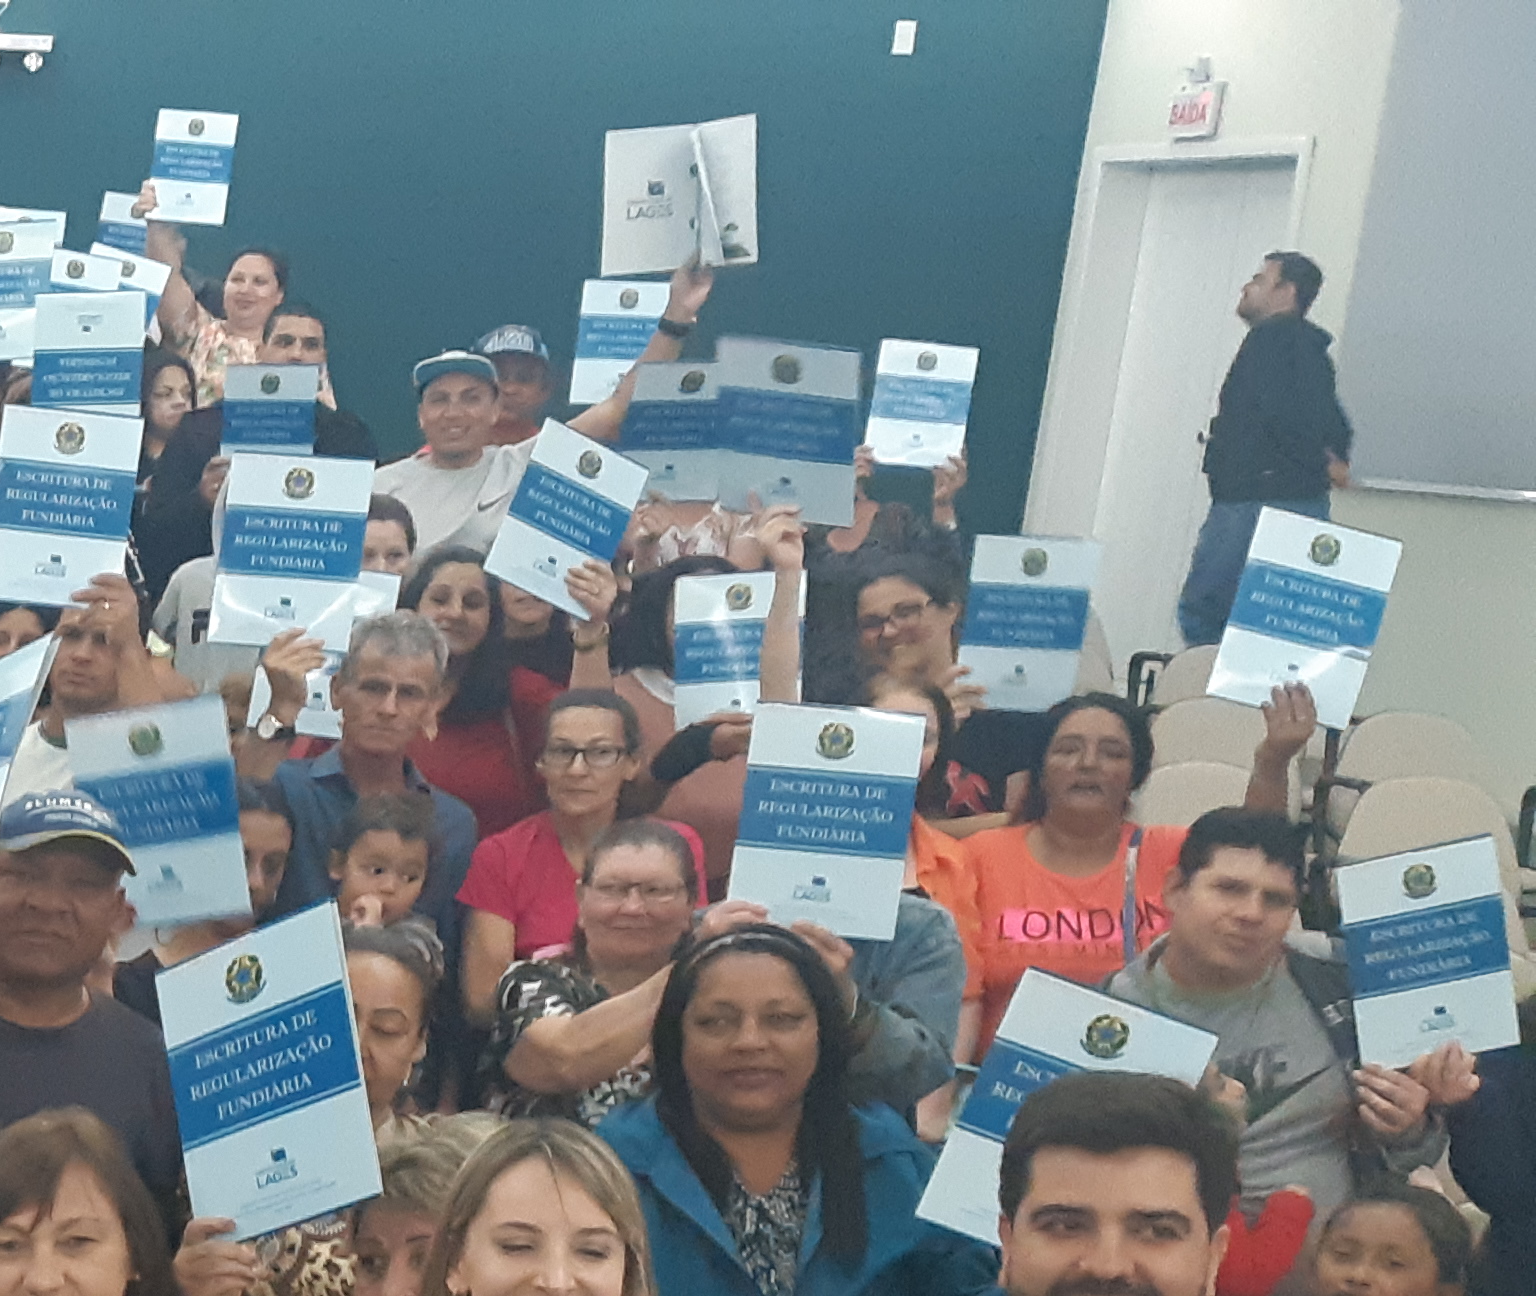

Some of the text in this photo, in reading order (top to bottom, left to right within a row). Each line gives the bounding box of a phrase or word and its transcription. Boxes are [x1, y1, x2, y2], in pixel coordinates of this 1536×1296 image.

[15, 469, 111, 491] ESCRITURA DE
[4, 487, 117, 511] REGULARIZAÇÃO
[537, 473, 612, 519] ESCRITURA DE
[19, 508, 95, 527] FUNDIÁRIA
[525, 485, 612, 538] REGULARIZAÇÃO
[243, 515, 342, 533] ESCRITURA DE
[533, 508, 592, 545] FUNDIÁRIA
[232, 533, 347, 553] REGULARIZAÇÃO
[248, 553, 325, 569] FUNDIÁRIA
[769, 778, 886, 800] ESCRITURA DE
[756, 799, 894, 825] REGULARIZAÇÃO
[776, 824, 868, 845] FUNDIÁRIA
[193, 1008, 316, 1071] ESCRITURA DE
[188, 1030, 332, 1104] REGULARIZAÇÃO
[216, 1068, 312, 1122] FUNDIÁRIA
